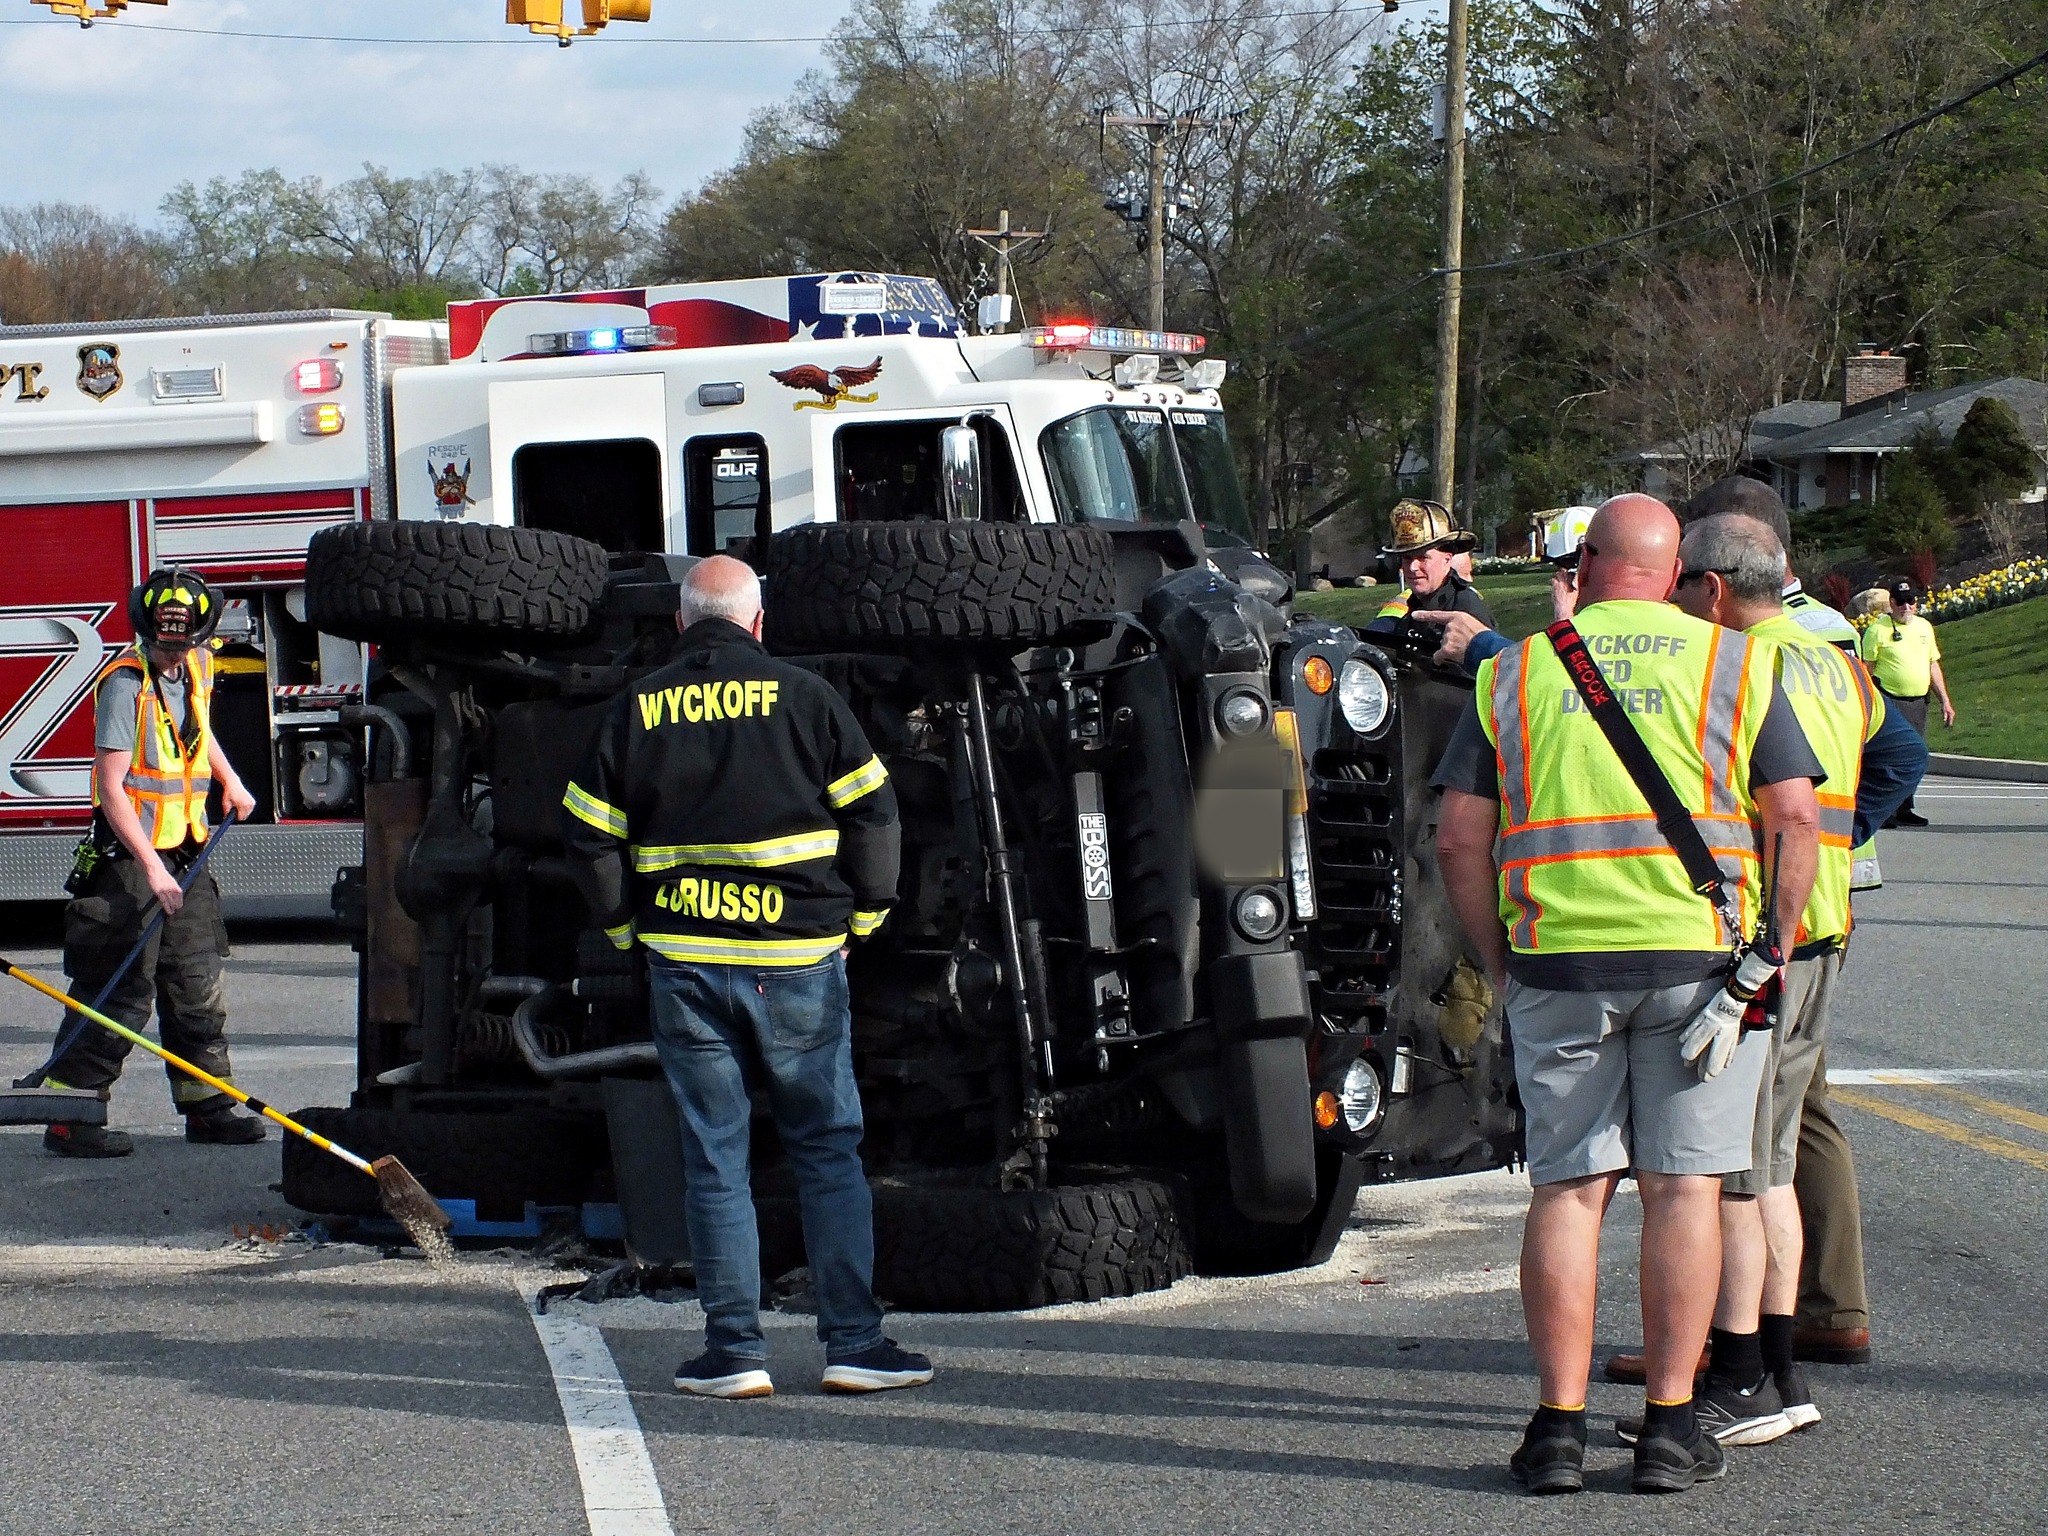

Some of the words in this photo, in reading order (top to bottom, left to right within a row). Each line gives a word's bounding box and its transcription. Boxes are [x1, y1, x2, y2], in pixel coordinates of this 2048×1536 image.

[428, 444, 468, 457] RESCUE
[1555, 634, 1688, 657] YCKOFF
[638, 680, 779, 730] WYCKOFF
[1562, 688, 1663, 715] DVER
[1081, 815, 1105, 829] THE
